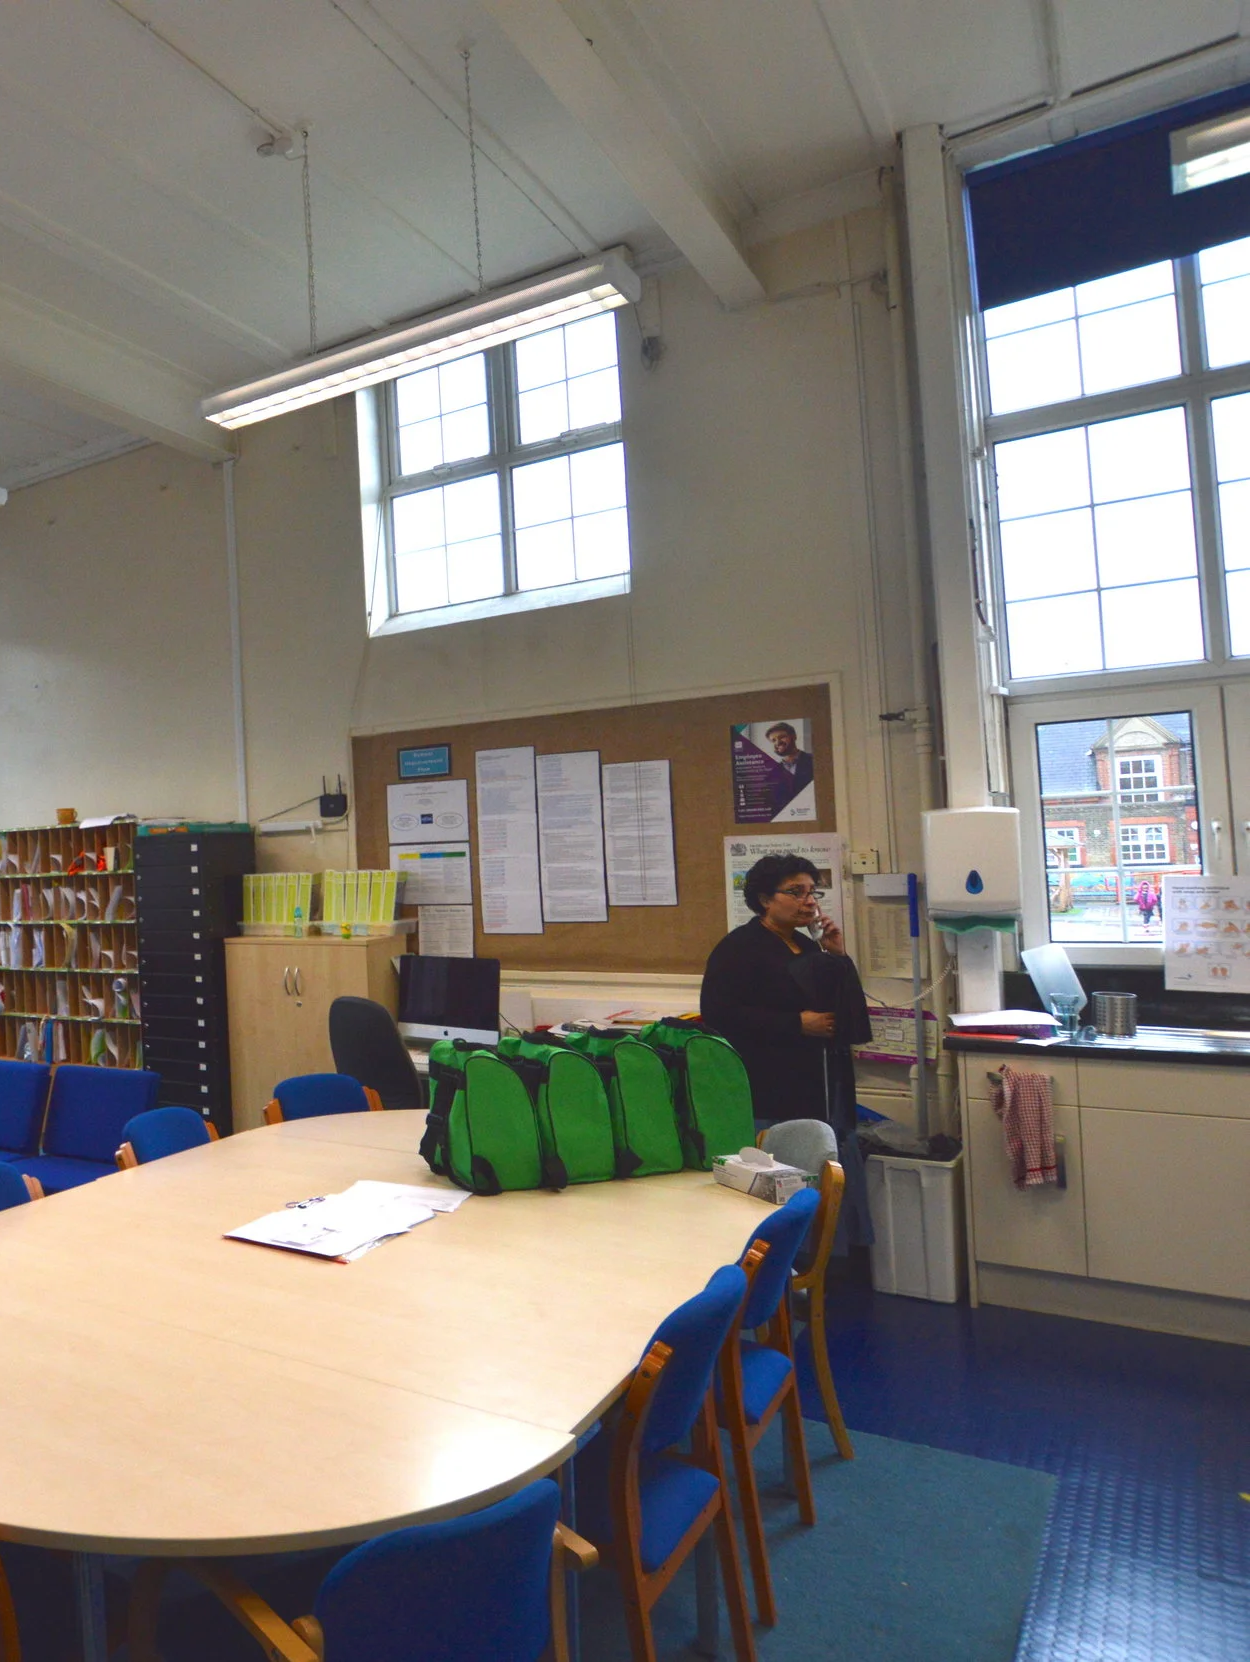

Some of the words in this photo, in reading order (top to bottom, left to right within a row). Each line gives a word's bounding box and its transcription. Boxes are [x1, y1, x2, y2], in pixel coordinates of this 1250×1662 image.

[750, 847, 768, 855] What
[782, 845, 800, 854] need
[810, 845, 831, 853] know
